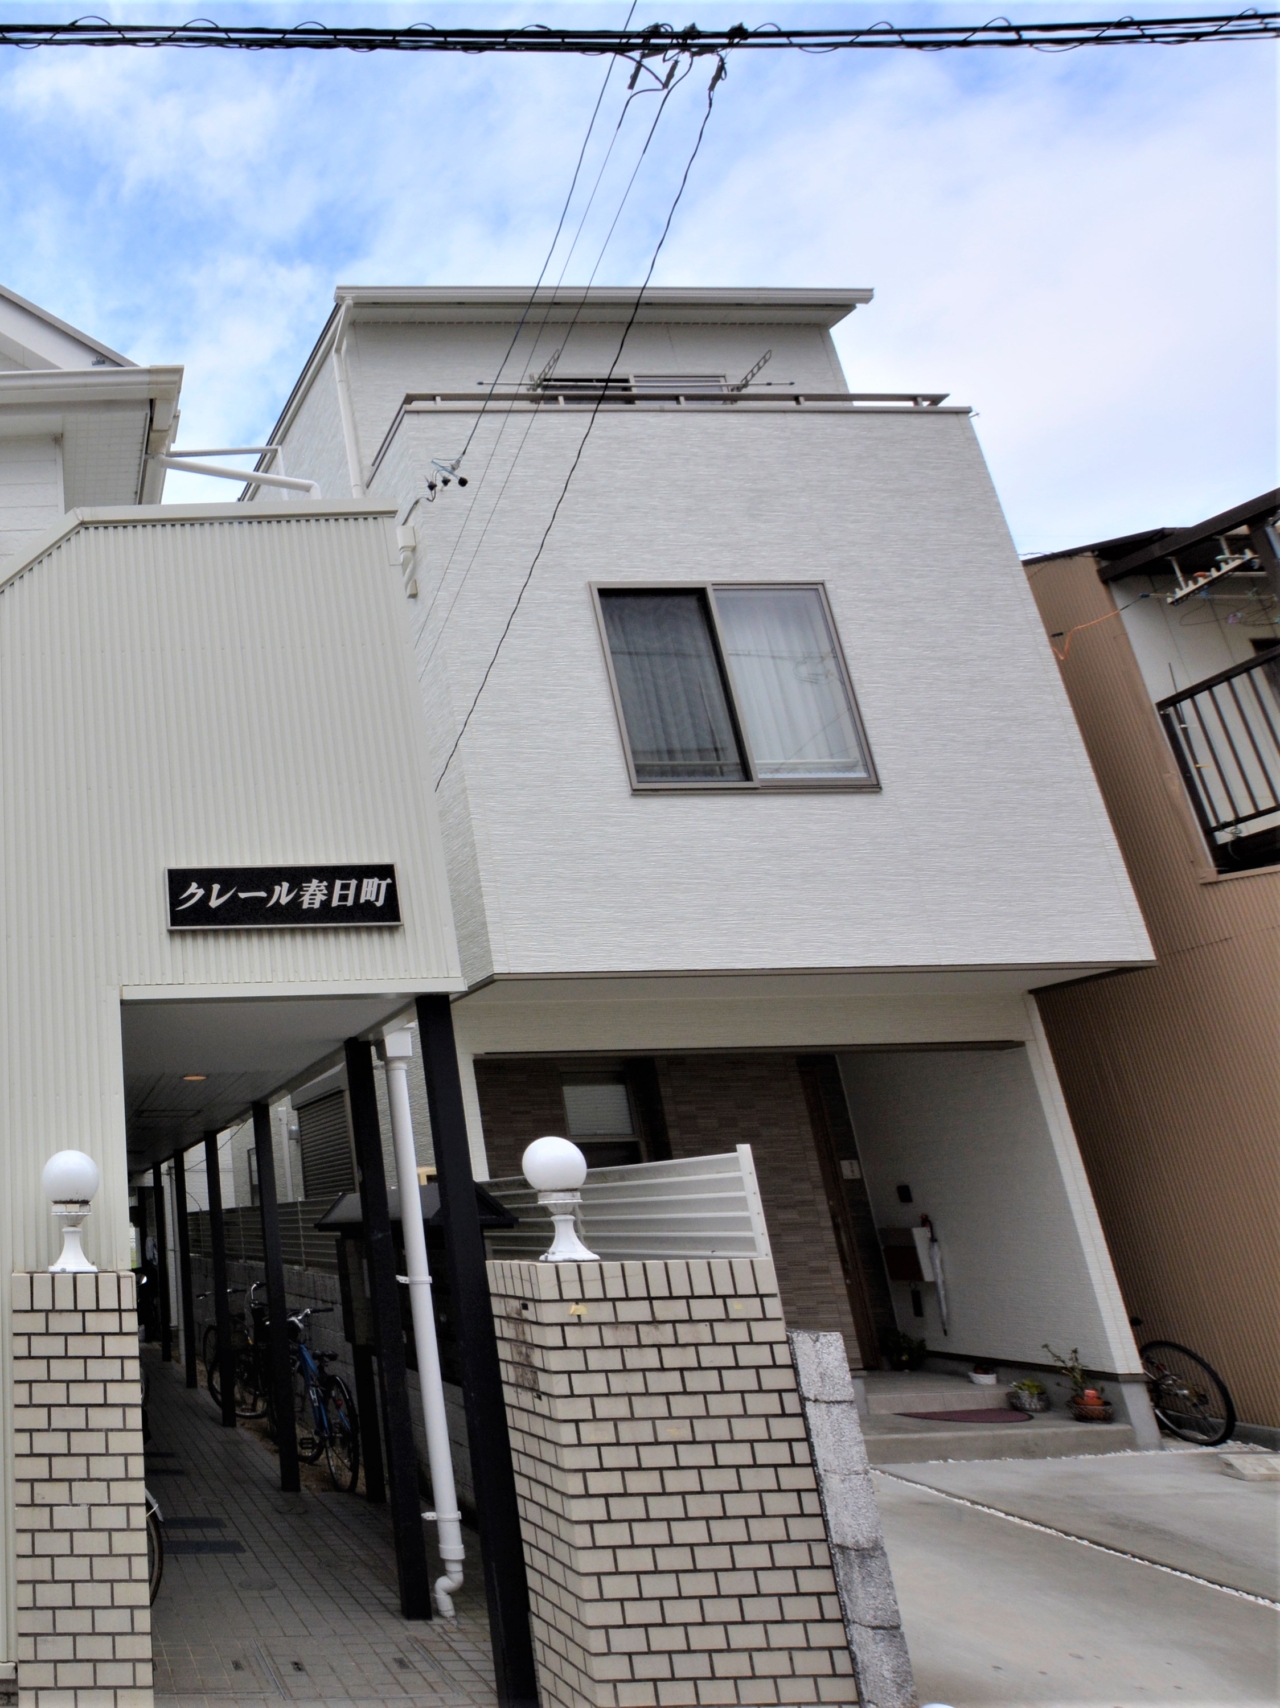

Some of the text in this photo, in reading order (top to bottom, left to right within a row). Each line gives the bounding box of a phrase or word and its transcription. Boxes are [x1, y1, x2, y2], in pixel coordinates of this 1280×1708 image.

[175, 877, 392, 911] クレール春日町
